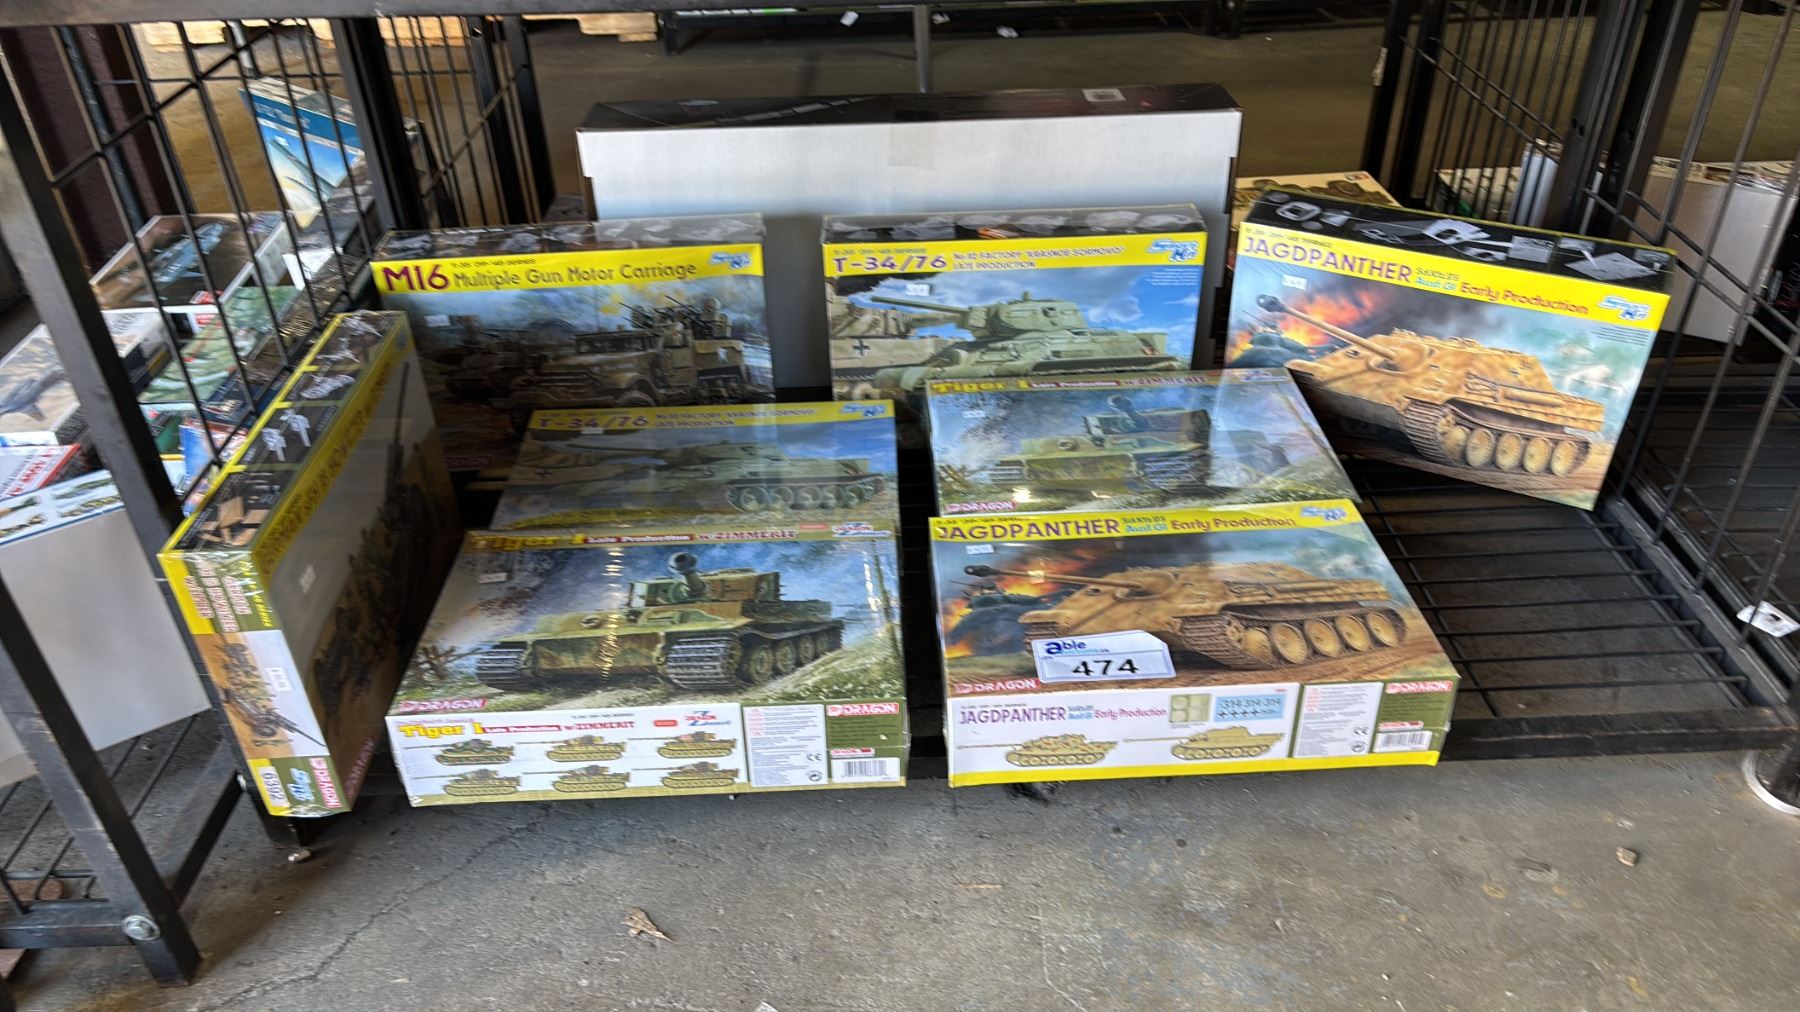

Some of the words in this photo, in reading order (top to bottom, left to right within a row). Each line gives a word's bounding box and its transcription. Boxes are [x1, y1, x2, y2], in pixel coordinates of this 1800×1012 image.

[833, 255, 947, 273] T-34/76
[1244, 237, 1413, 283] JAGDPANTHER
[382, 264, 449, 291] M16
[453, 269, 521, 290] Multiple
[526, 268, 563, 284] Gun
[567, 265, 615, 282] Motor
[620, 262, 697, 281] Carriage
[1461, 282, 1499, 302] Early
[1502, 289, 1589, 315] Production
[938, 518, 1120, 540] JAGDPANTHER
[1171, 518, 1211, 532] Early
[1213, 516, 1297, 529] Production
[1045, 641, 1087, 655] able
[1072, 659, 1139, 676] 474
[975, 679, 1037, 693] DRAGON
[416, 699, 482, 711] DRAGON
[844, 703, 897, 714] DRAGON
[1119, 707, 1168, 718] Production
[960, 706, 1067, 725] JAGDPANTHER
[399, 724, 464, 739] Tiger
[262, 772, 285, 800] 6392
[316, 768, 342, 808] DRAGON
